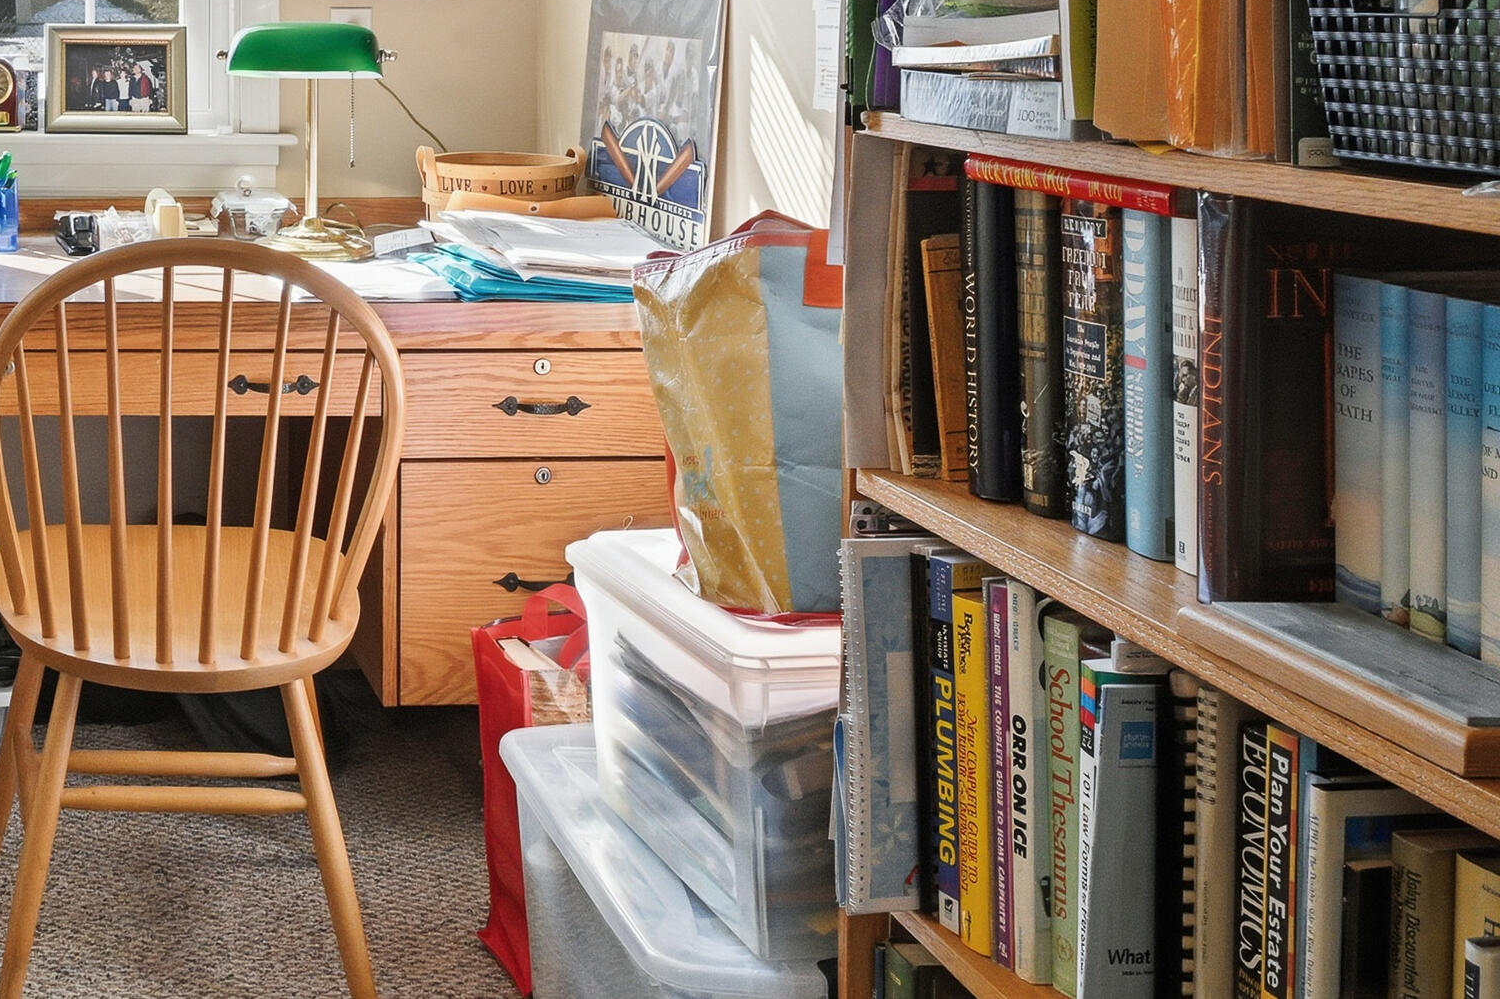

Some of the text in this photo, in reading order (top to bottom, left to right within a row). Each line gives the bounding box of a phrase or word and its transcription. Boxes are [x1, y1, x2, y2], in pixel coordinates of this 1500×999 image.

[441, 176, 473, 194] LIVE
[500, 180, 534, 195] LOVE
[613, 197, 699, 246] UBHOUSE
[1124, 212, 1147, 356] D-DAY
[964, 271, 977, 364] WORLD
[1201, 314, 1222, 487] INDIANS
[1336, 364, 1375, 383] RAPES
[1340, 383, 1357, 399] OF
[965, 368, 979, 474] HISTORY
[1336, 403, 1373, 423] RATH
[1449, 404, 1481, 418] ALLEY
[935, 675, 955, 867] PLUMBING
[966, 749, 978, 819] COMPLETE
[1011, 713, 1028, 859] ORR ON ICE
[1048, 665, 1075, 921] School Thesaurus
[1082, 771, 1091, 792] 101
[993, 685, 1007, 933] THE COMPLETE GUIDE TO HOME CARPENTRY
[1082, 803, 1091, 836] Law
[967, 819, 979, 864] GUIDE
[1080, 839, 1091, 890] Forms
[1240, 733, 1268, 972] ECONOMICS
[1266, 752, 1289, 990] Plan Your Estate
[968, 865, 979, 884] TO
[1108, 947, 1151, 966] What
[1403, 913, 1421, 993] Discounted
